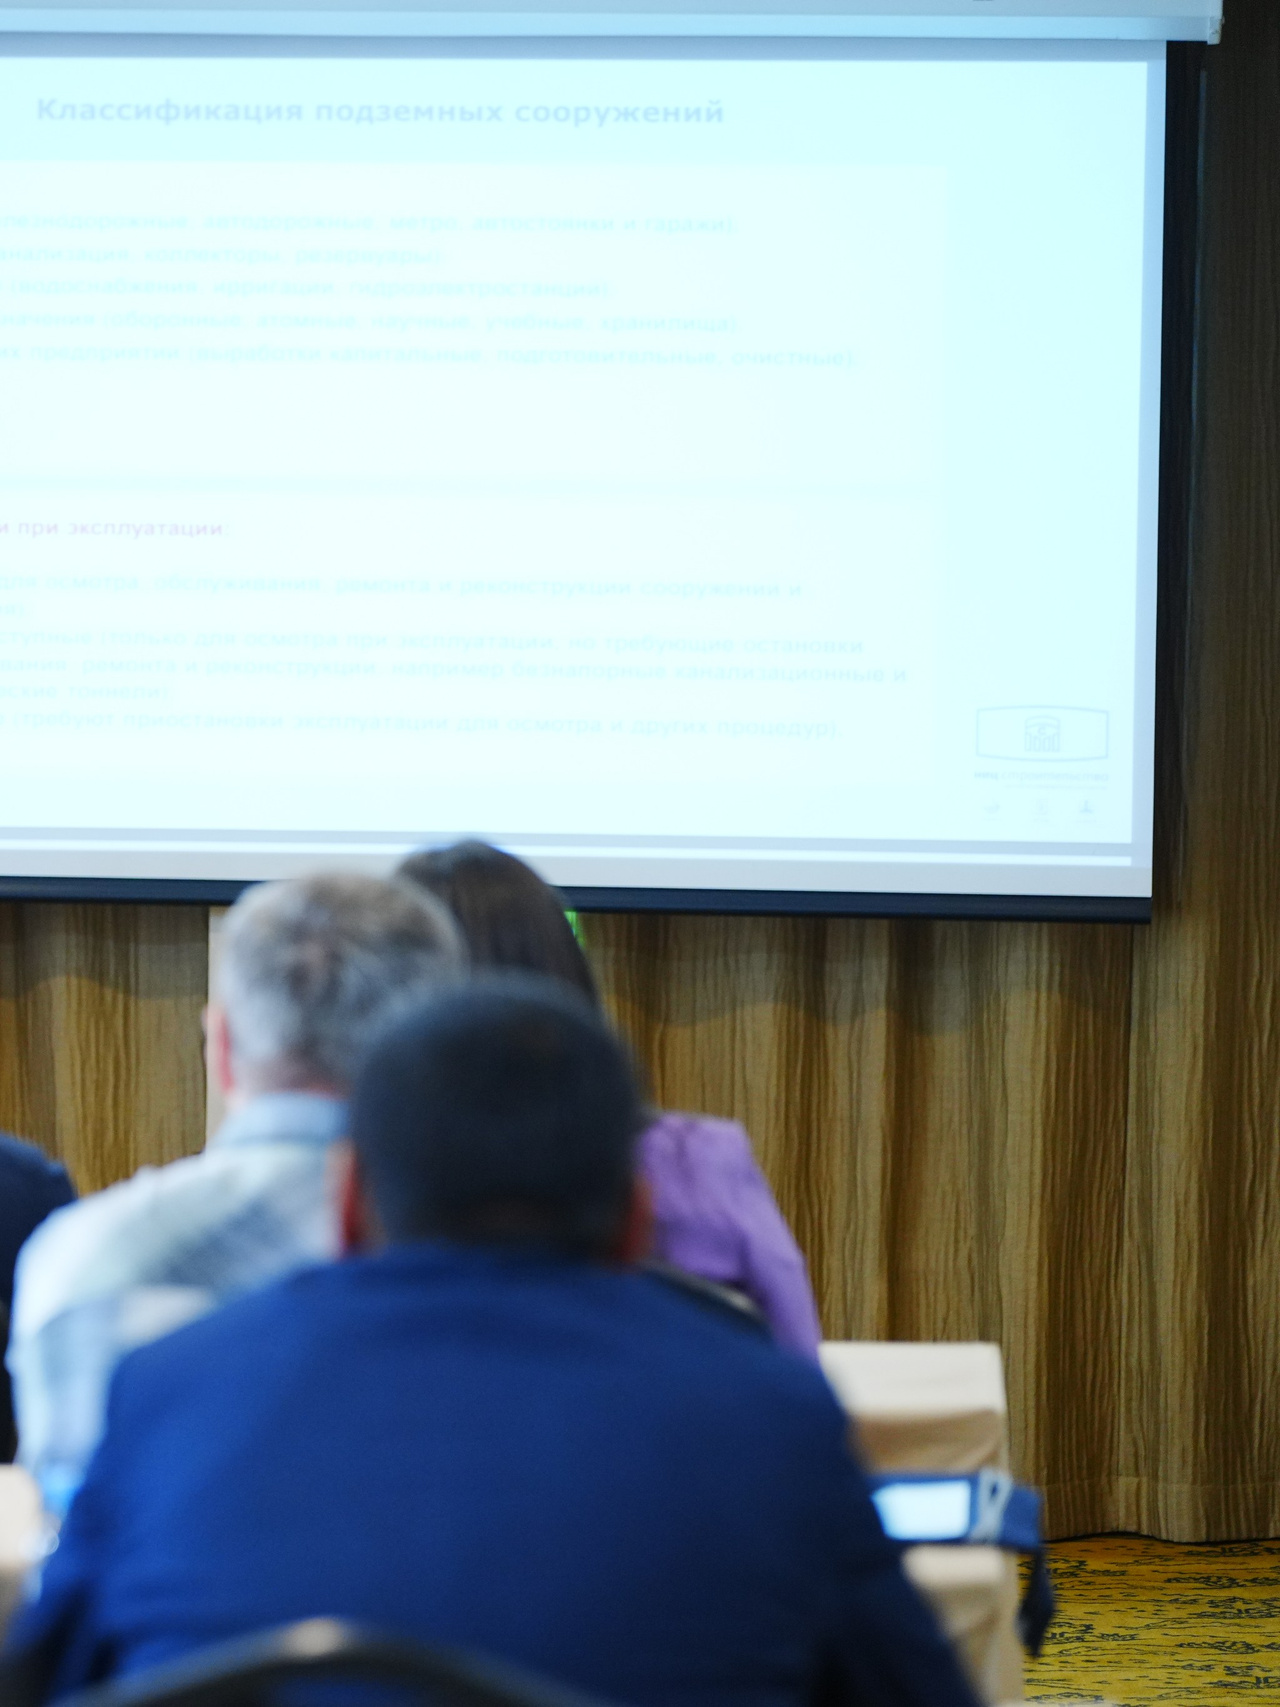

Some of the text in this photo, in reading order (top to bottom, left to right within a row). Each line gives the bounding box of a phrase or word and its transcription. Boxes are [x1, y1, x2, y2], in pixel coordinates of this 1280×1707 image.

[36, 98, 725, 125] Классификация подземных сооружений
[623, 217, 637, 230] и
[17, 519, 59, 539] при
[67, 519, 231, 539] эксплуатации:
